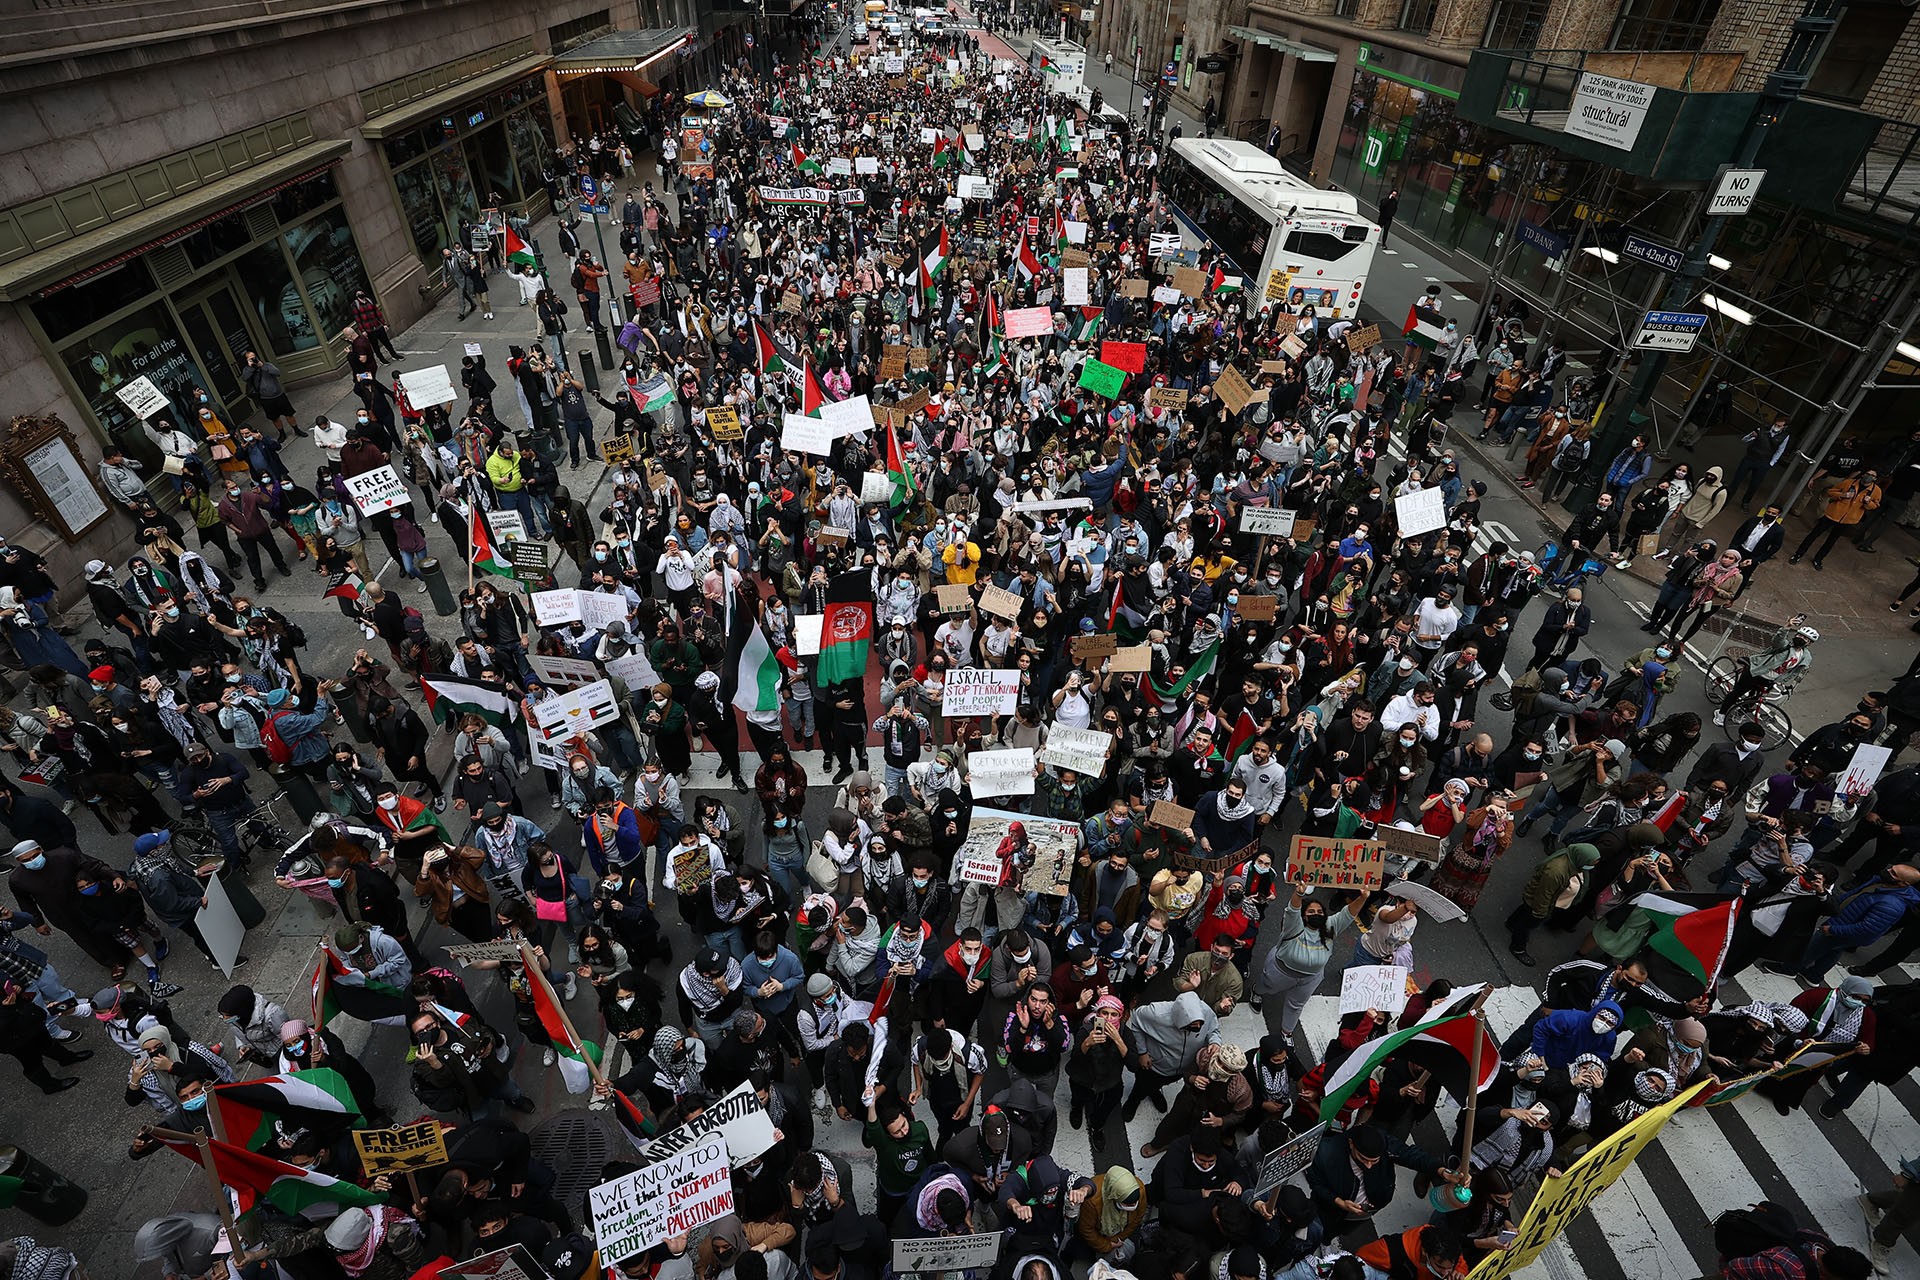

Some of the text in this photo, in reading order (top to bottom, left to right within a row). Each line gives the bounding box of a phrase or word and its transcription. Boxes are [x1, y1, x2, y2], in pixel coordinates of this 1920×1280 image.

[1589, 76, 1645, 96] 125 PARK AVENUE
[1581, 84, 1647, 106] NEW YORK, NY 10017
[1729, 178, 1749, 190] NO
[762, 189, 781, 199] FROM
[783, 190, 796, 199] THE
[815, 190, 826, 202] TO
[1715, 196, 1751, 207] TURNS
[1523, 226, 1554, 250] TD BANK
[1626, 241, 1678, 268] East 42nd St
[1680, 316, 1702, 324] LANE
[1658, 336, 1690, 344] 7AM-7PM
[132, 339, 176, 370] For all the
[168, 352, 188, 371] that
[1156, 388, 1180, 398] FREE
[1150, 398, 1186, 408] PALESTINE
[713, 416, 734, 424] CAPITAL
[604, 435, 629, 450] FREE
[353, 470, 392, 492] FREE
[948, 670, 1002, 688] ISRAEL,
[579, 685, 604, 700] AMERICAN
[946, 686, 970, 696] STOP
[541, 702, 560, 714] ISRAELI
[948, 697, 965, 706] MY
[1048, 725, 1072, 741] STOP
[1042, 750, 1065, 765] FREE
[995, 782, 1018, 792] NECK
[1297, 838, 1330, 861] From
[1332, 842, 1351, 861] the
[674, 850, 695, 866] END
[968, 861, 998, 874] Israeli
[1286, 864, 1381, 886] Palestine Will be Free
[964, 870, 997, 884] Crimes
[1378, 968, 1398, 980] FREE
[359, 1123, 434, 1146] FREE
[646, 1091, 760, 1163] NEVER FORGOTTEN
[364, 1138, 437, 1154] PALESTINE
[634, 1157, 684, 1192] KNOW
[688, 1144, 720, 1168] TOO
[1562, 1133, 1637, 1192] THE
[594, 1172, 700, 1222] well that OUR
[600, 1166, 730, 1240] freedom IS INCOMPLETE
[1528, 1170, 1604, 1232] NOT
[626, 1203, 683, 1236] WITHOUT THE
[599, 1230, 647, 1267] FREEDOM
[654, 1221, 668, 1234] the
[666, 1190, 734, 1236] PALESTINIANS
[920, 1236, 992, 1246] ANNEXATION
[920, 1242, 992, 1252] OCCUPATION
